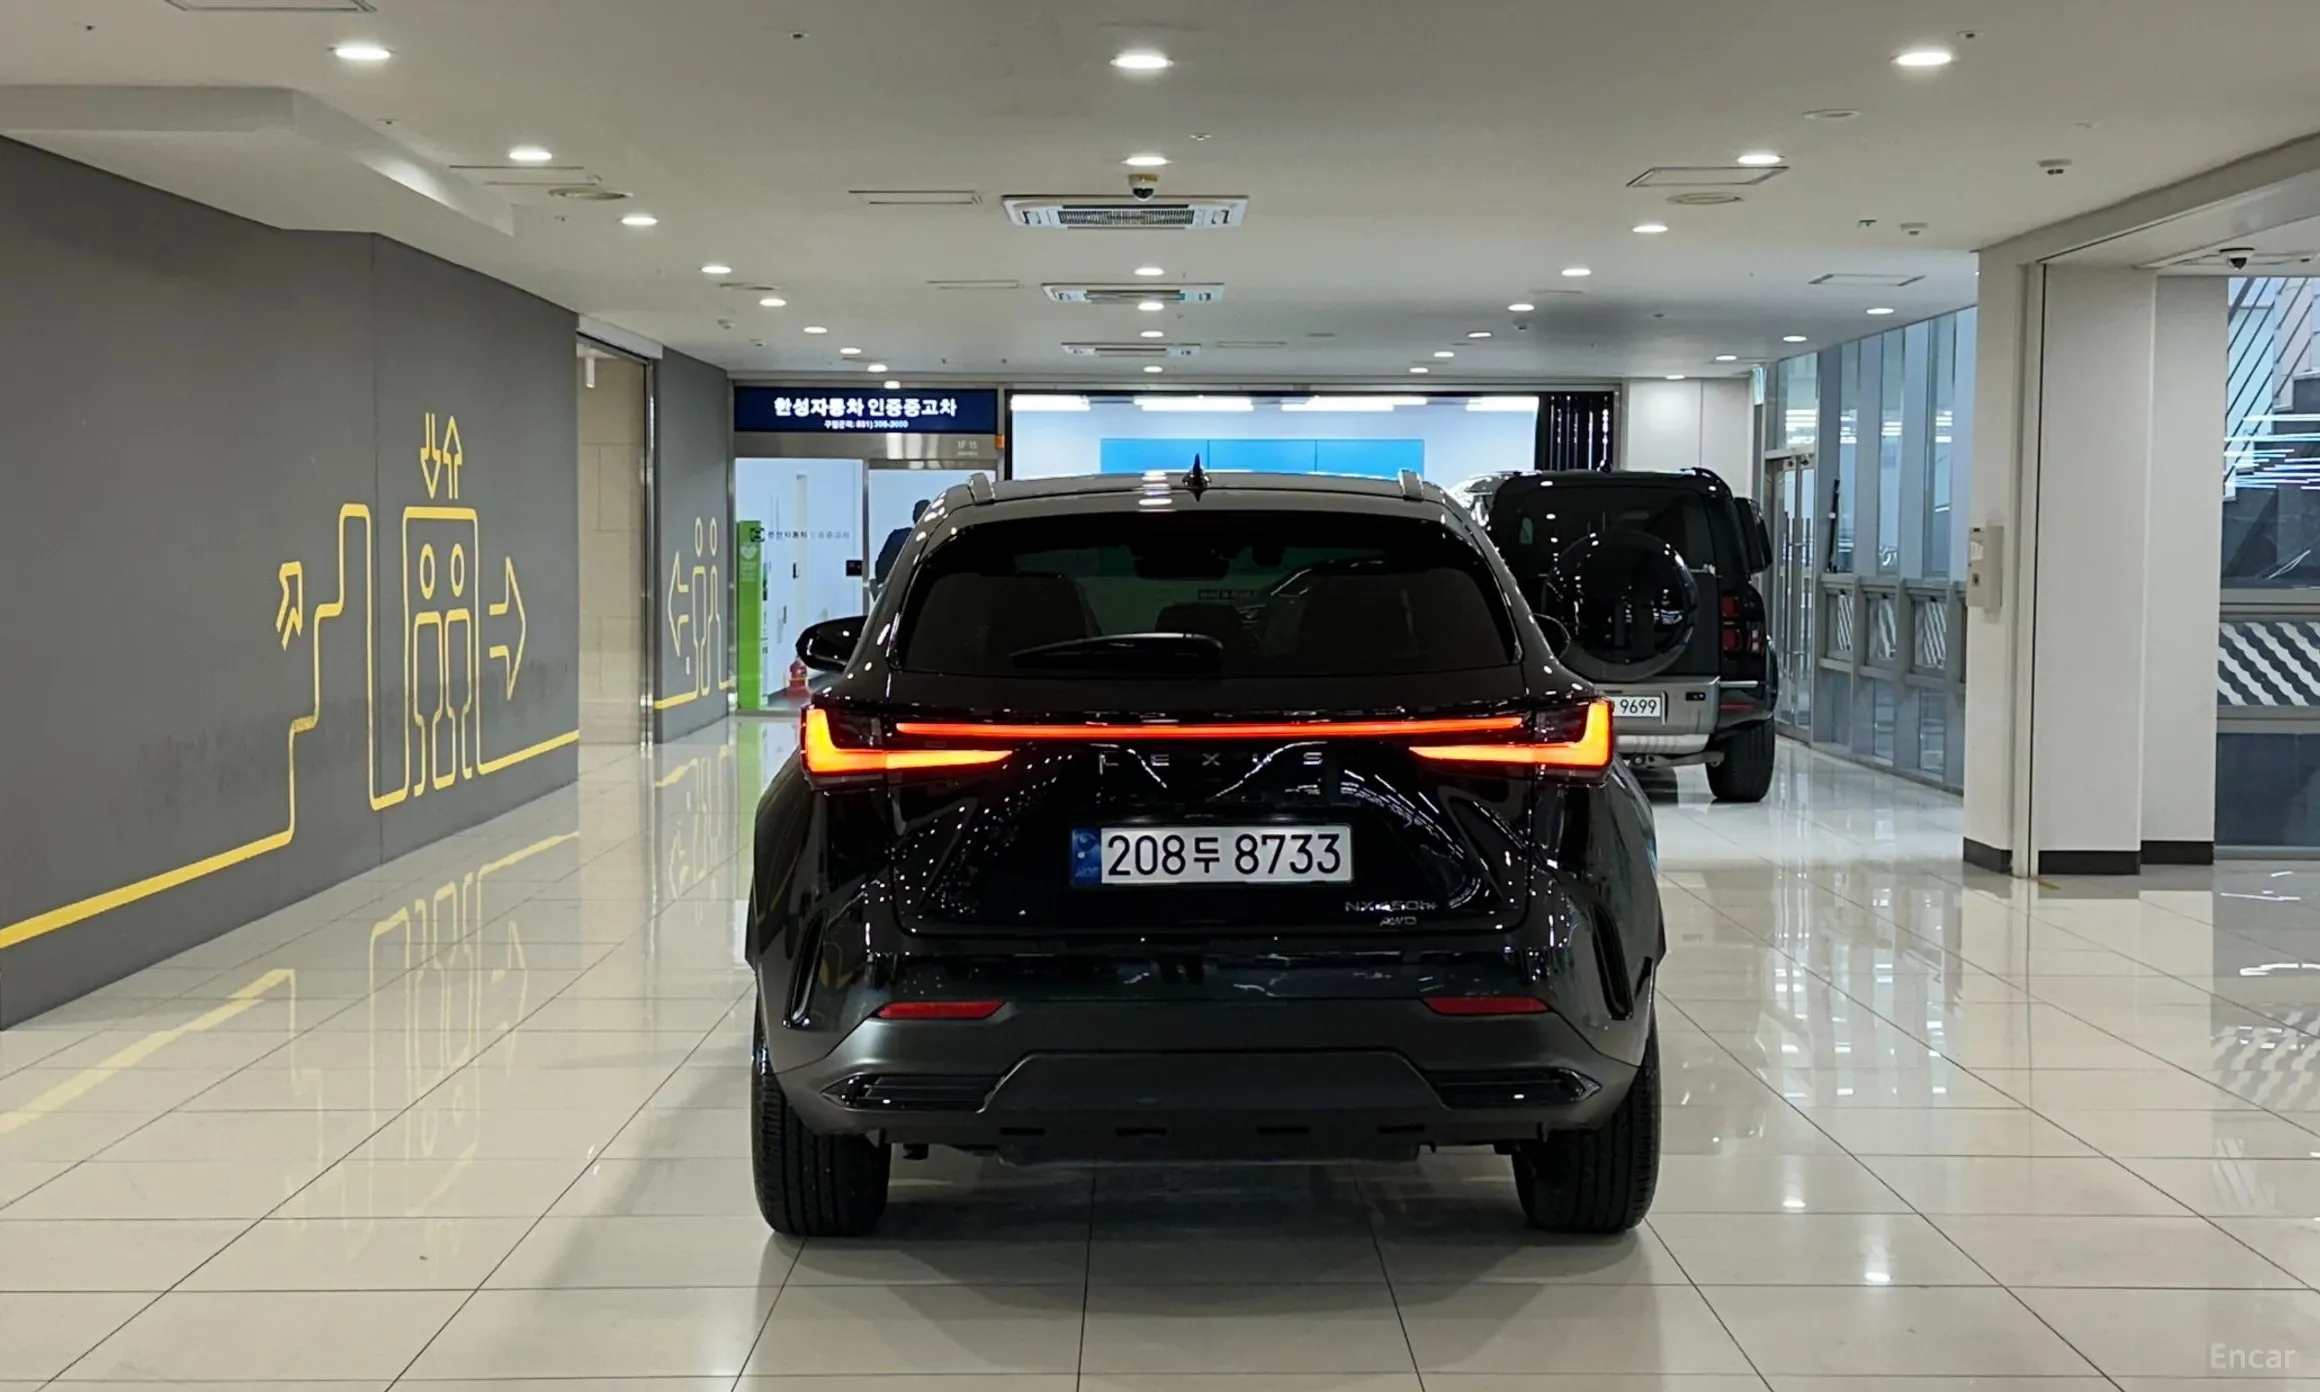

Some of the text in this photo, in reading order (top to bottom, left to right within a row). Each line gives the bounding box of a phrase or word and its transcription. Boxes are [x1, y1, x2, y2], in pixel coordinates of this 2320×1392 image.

[774, 397, 957, 417] 한성자동차 인증중고차
[1620, 699, 1657, 714] 9699
[1107, 833, 1341, 876] 208두 8733
